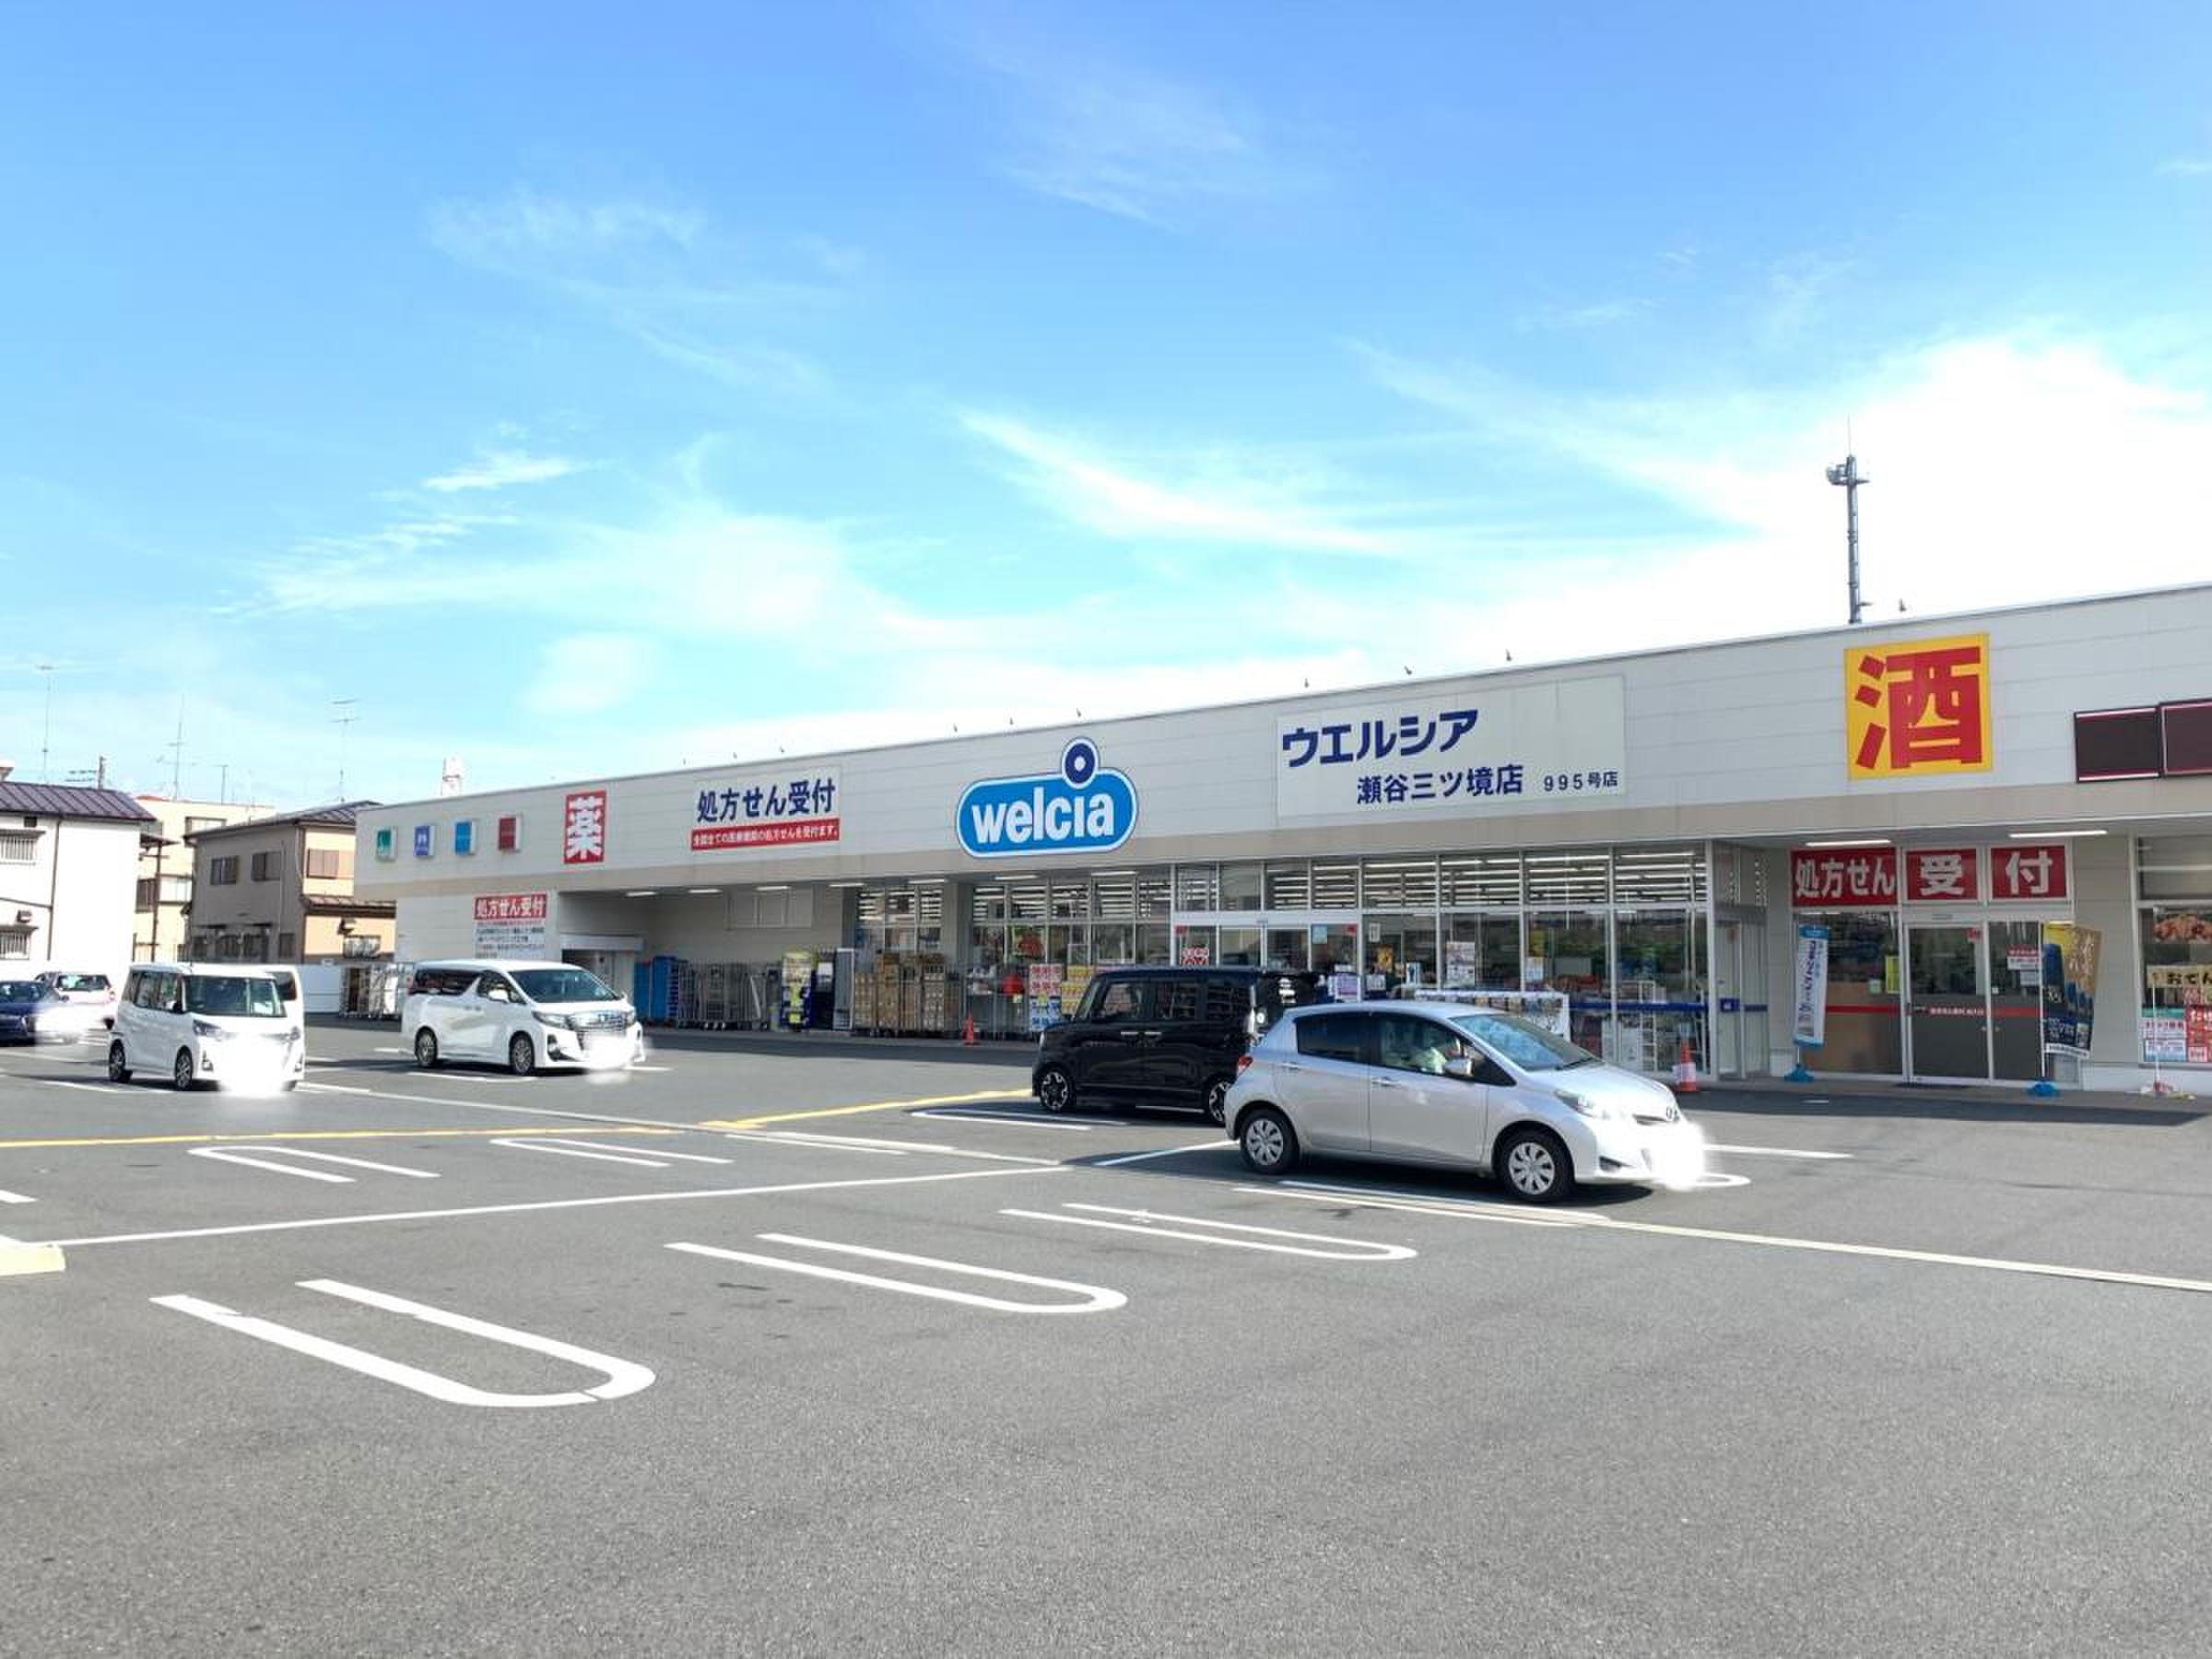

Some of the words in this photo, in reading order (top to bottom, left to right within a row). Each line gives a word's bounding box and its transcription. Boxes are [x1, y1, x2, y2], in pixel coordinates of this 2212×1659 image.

[1854, 646, 1983, 770] 酒
[1282, 709, 1478, 767] ウエルシア
[697, 778, 836, 822] 処方せん受付
[971, 742, 1115, 843] welcia
[1357, 764, 1524, 805] 瀬谷三ツ境店
[1543, 771, 1618, 793] 995号店
[566, 795, 603, 861] 薬
[1795, 857, 1895, 897] 処方せん
[1921, 853, 1963, 895] 受
[2006, 852, 2053, 894] 付
[476, 895, 546, 917] 処方せん受付
